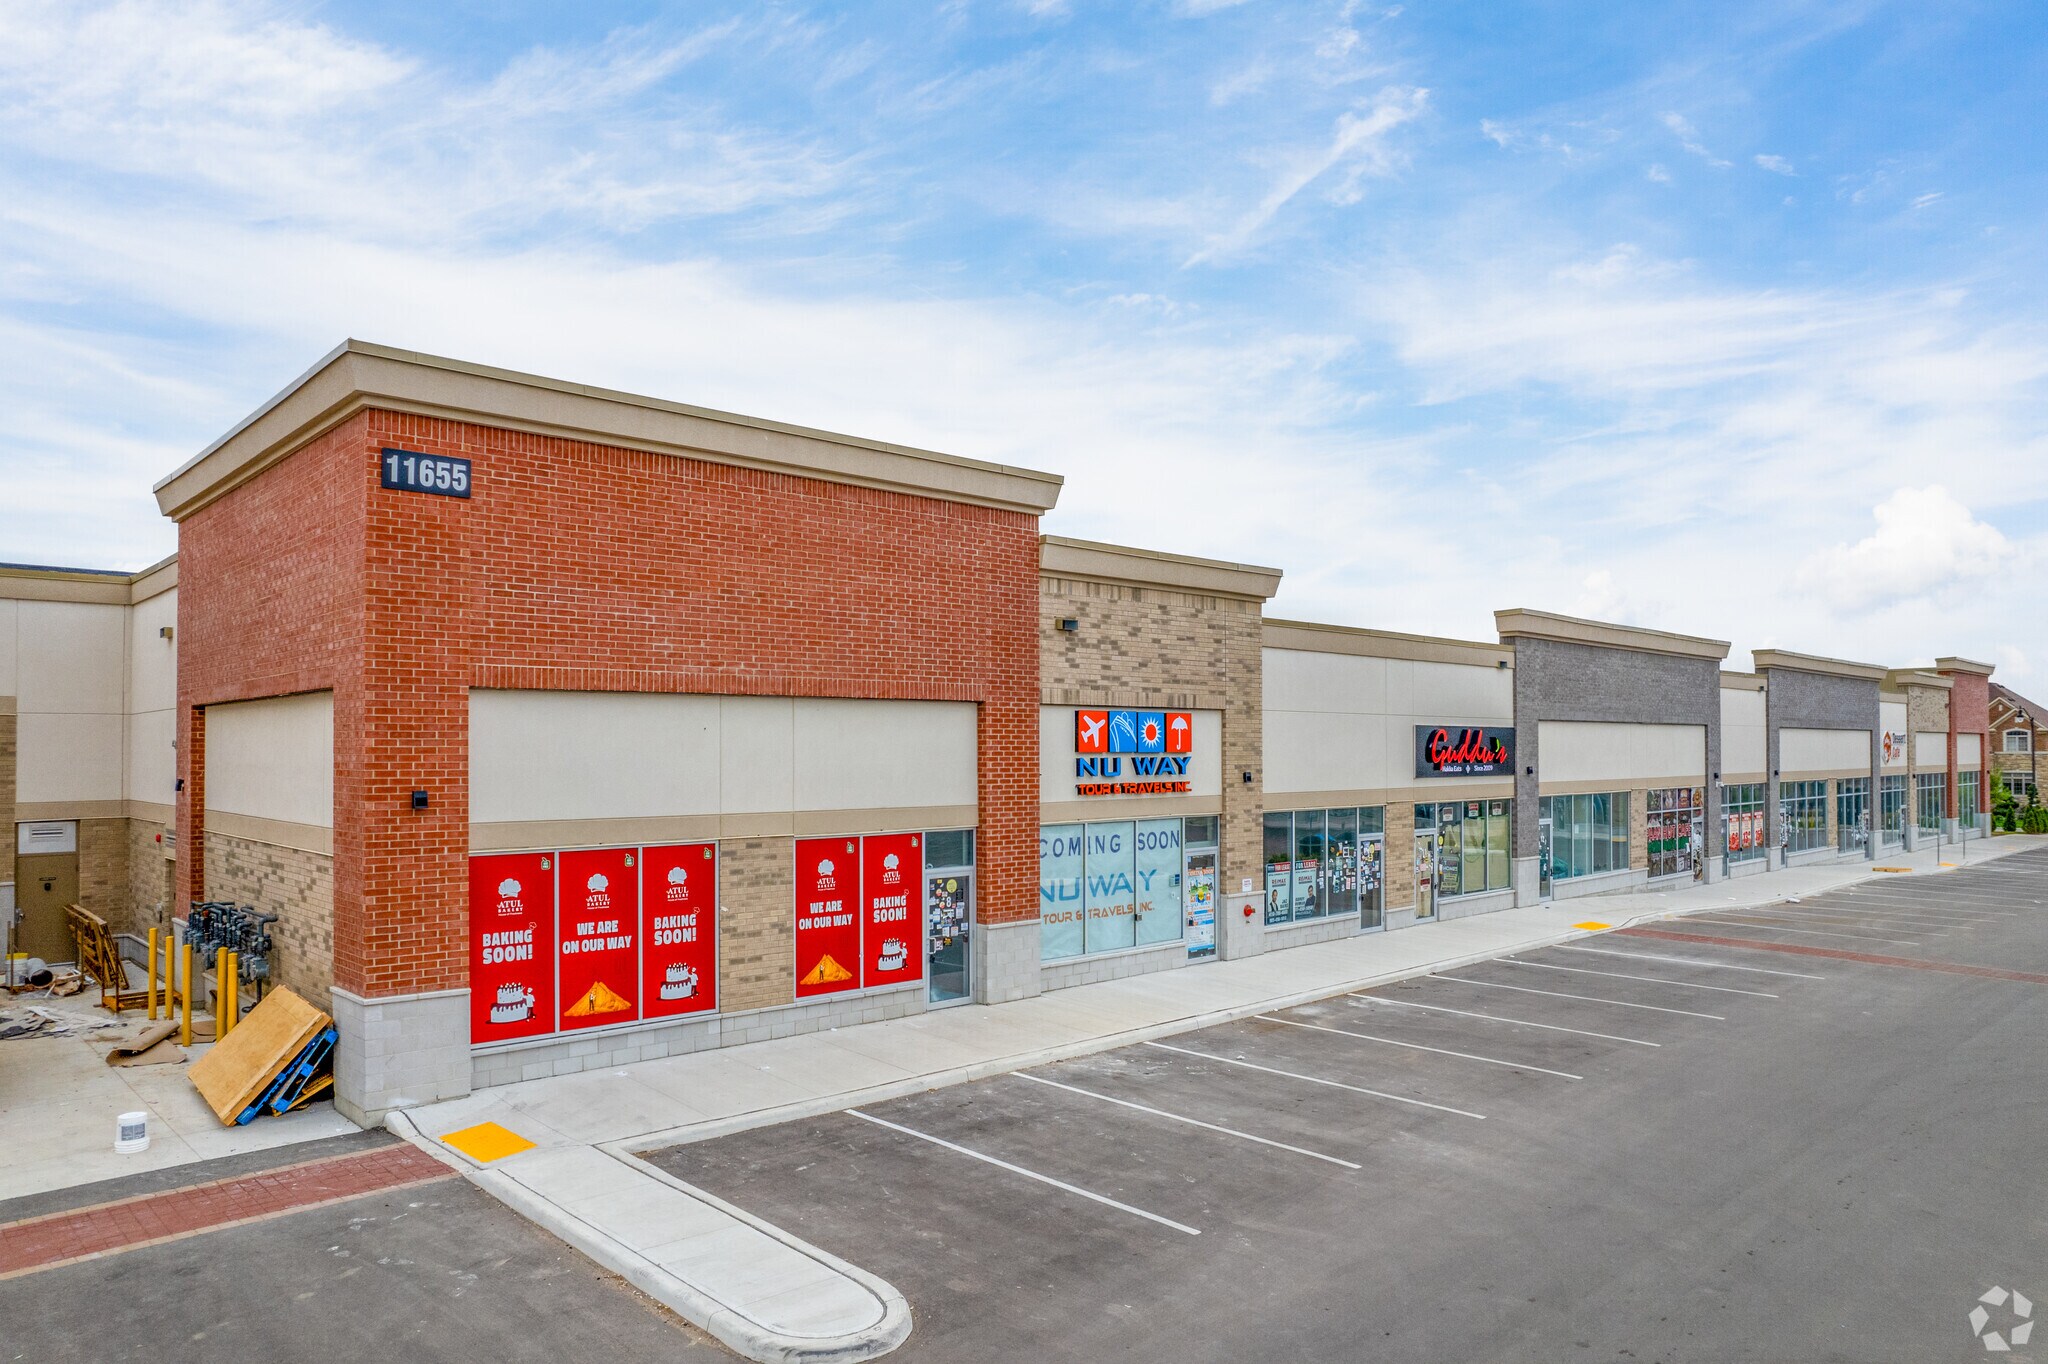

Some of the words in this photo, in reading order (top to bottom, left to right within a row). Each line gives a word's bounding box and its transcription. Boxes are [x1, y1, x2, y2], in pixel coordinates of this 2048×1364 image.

[386, 454, 468, 492] 11655
[1431, 728, 1508, 771] Guddu's
[1076, 757, 1121, 778] NU
[1131, 755, 1191, 775] WAY
[1077, 783, 1111, 796] TOUR
[1112, 782, 1121, 795] &
[1122, 781, 1173, 794] TRAVELS
[1040, 834, 1121, 859] COMING
[1137, 830, 1180, 851] SOON
[817, 877, 836, 885] ATUL
[883, 870, 901, 878] ATUL
[666, 886, 689, 895] ATUL
[1040, 877, 1080, 903] NU
[1088, 869, 1157, 898] WAY
[497, 900, 524, 909] ATUL
[585, 894, 610, 902] ATUL
[873, 895, 907, 909] BAKING
[810, 901, 824, 914] WE
[825, 900, 843, 912] ARE
[873, 906, 907, 924] SOON!
[1043, 911, 1073, 925] TOUR
[1075, 910, 1083, 920] &
[1088, 903, 1135, 919] TRAVELS
[1139, 901, 1155, 912] INC.
[577, 922, 595, 936] WE
[597, 920, 619, 934] ARE
[654, 913, 697, 930] BAKING
[799, 918, 812, 930] ON
[813, 916, 832, 928] OUR
[833, 914, 853, 926] WAY
[482, 929, 533, 947] BAKING
[562, 941, 580, 955] ON
[581, 938, 605, 952] OUR
[606, 935, 632, 950] WAY
[654, 927, 697, 946] SOON!
[482, 944, 533, 965] SOON!
